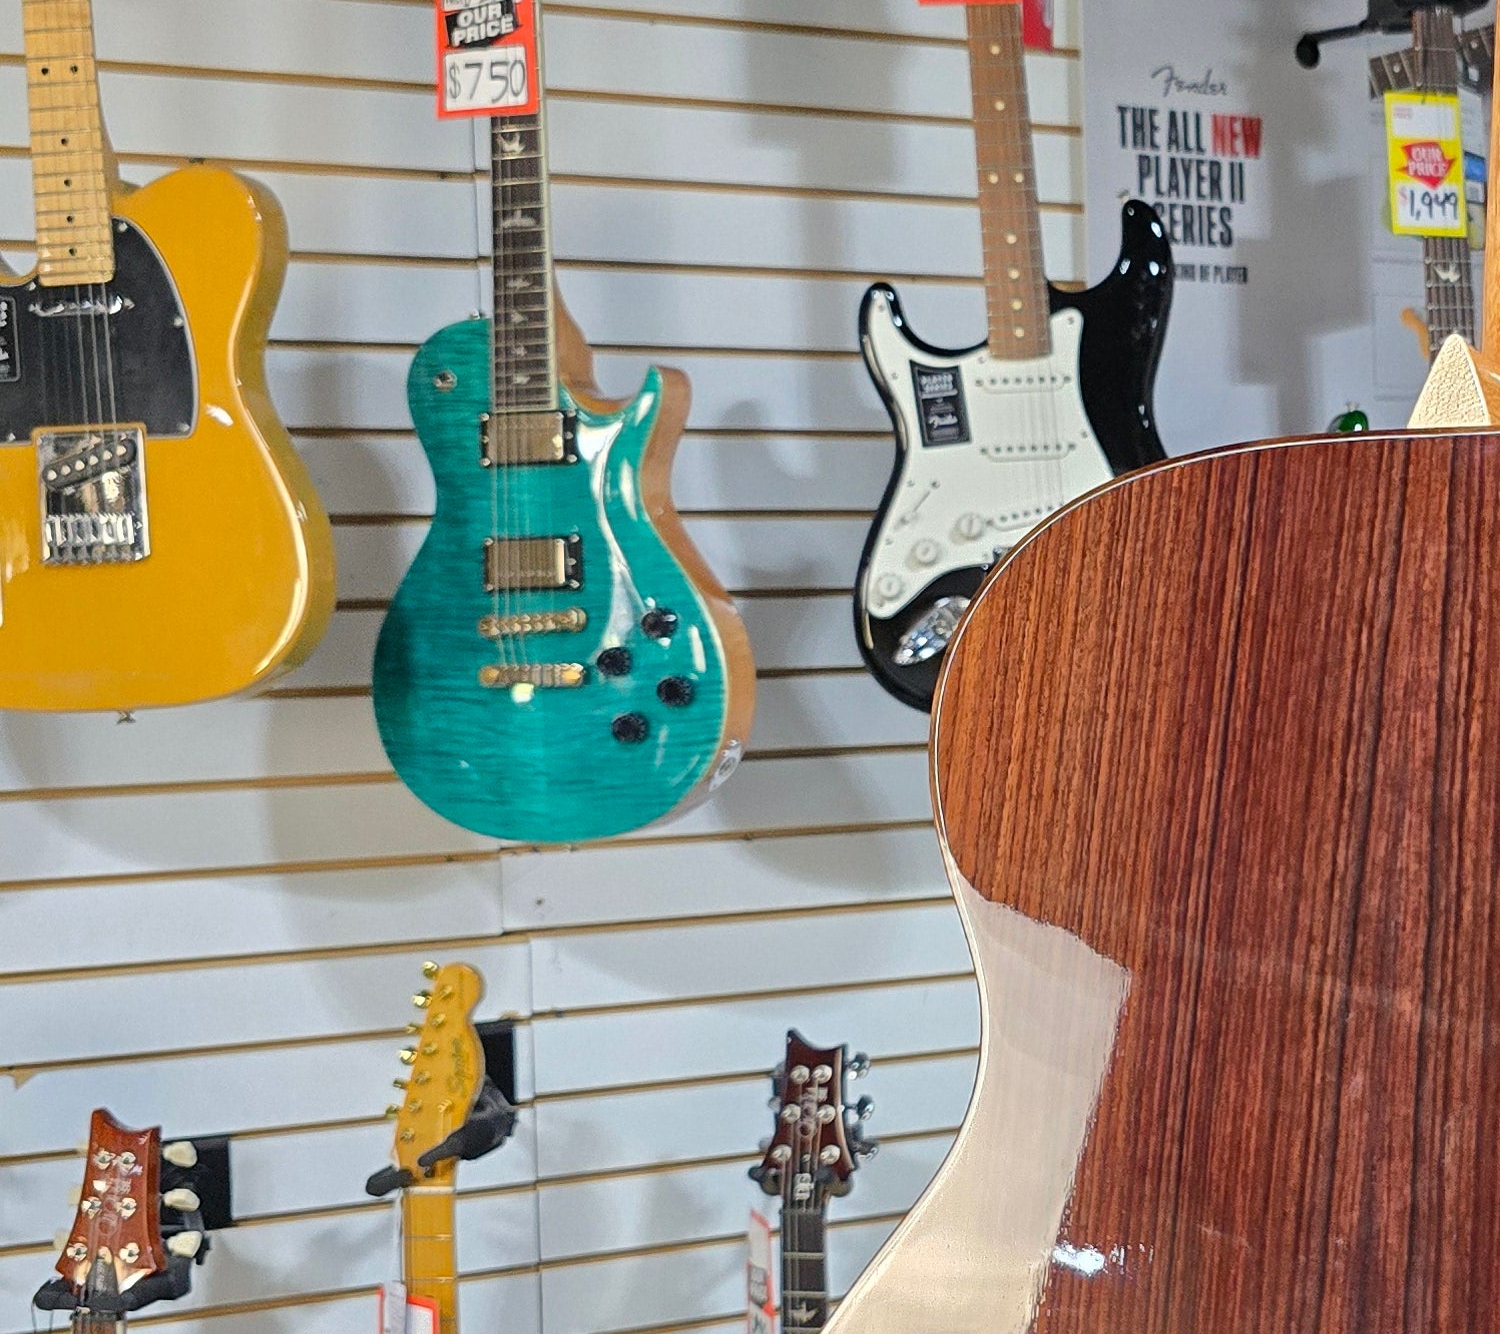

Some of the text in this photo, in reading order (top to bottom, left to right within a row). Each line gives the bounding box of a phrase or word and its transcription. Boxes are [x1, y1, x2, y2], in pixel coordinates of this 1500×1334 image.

[452, 13, 514, 47] PRICE
[457, 3, 502, 27] OUR
[449, 60, 525, 103] $750
[1151, 66, 1228, 97] Fender
[1117, 105, 1263, 159] THE ALL NEW
[1408, 161, 1447, 177] PRICE
[1411, 147, 1443, 163] OUR
[1137, 154, 1246, 204] PLAYER II
